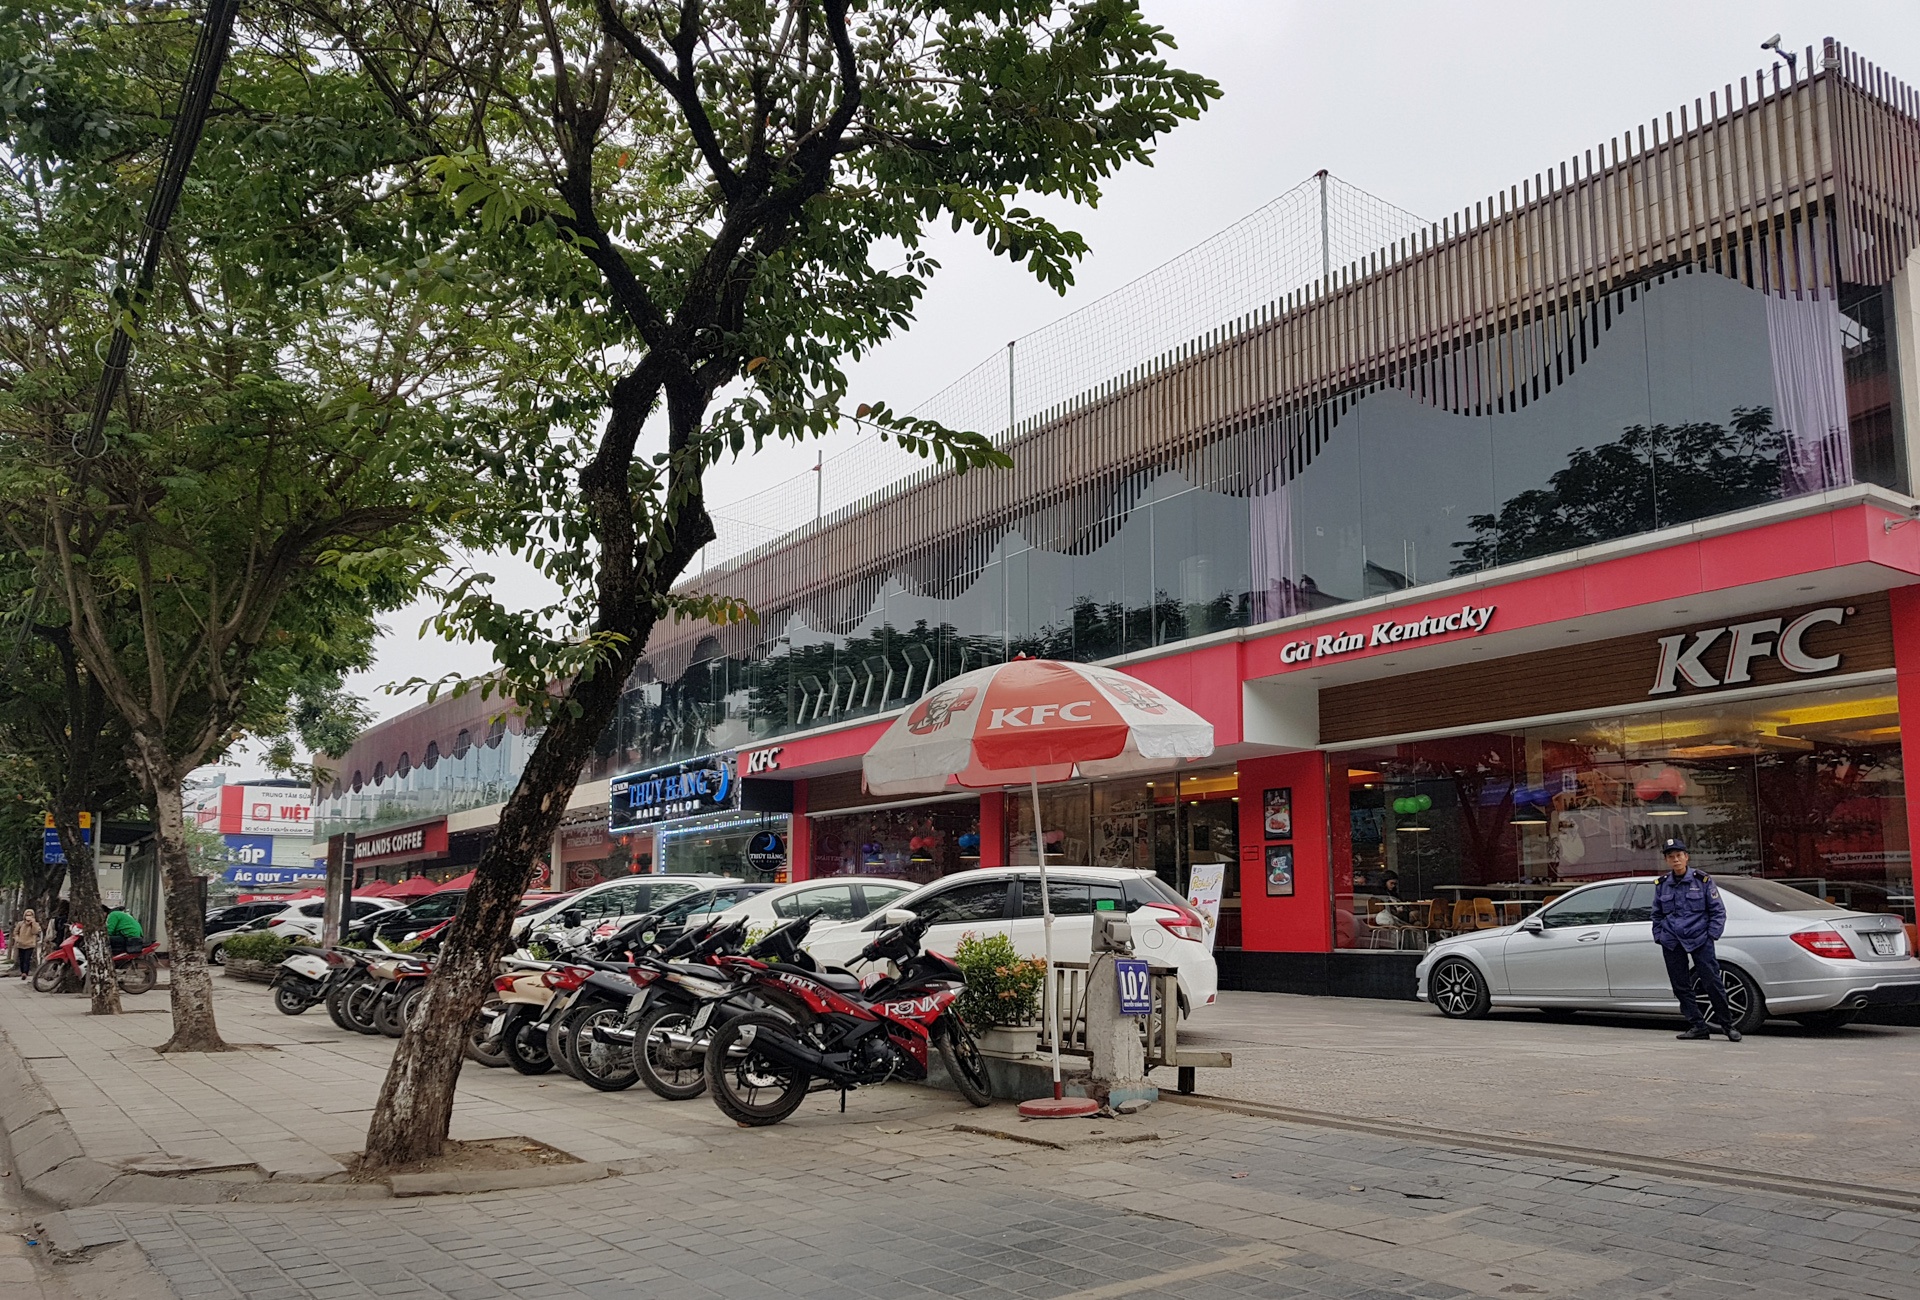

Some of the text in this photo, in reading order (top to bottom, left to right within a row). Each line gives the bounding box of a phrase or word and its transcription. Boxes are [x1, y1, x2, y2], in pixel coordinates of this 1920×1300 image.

[1280, 605, 1495, 663] Gà Rán Kentucky
[1648, 607, 1844, 695] KFC
[986, 701, 1092, 730] KFC
[746, 746, 779, 774] KFC
[280, 803, 311, 823] VIỆT
[636, 799, 700, 819] HAIR SALON
[353, 830, 423, 859] IGHLANDS COFFEE
[255, 872, 281, 882] QUY
[1120, 965, 1149, 1000] LÔ 2
